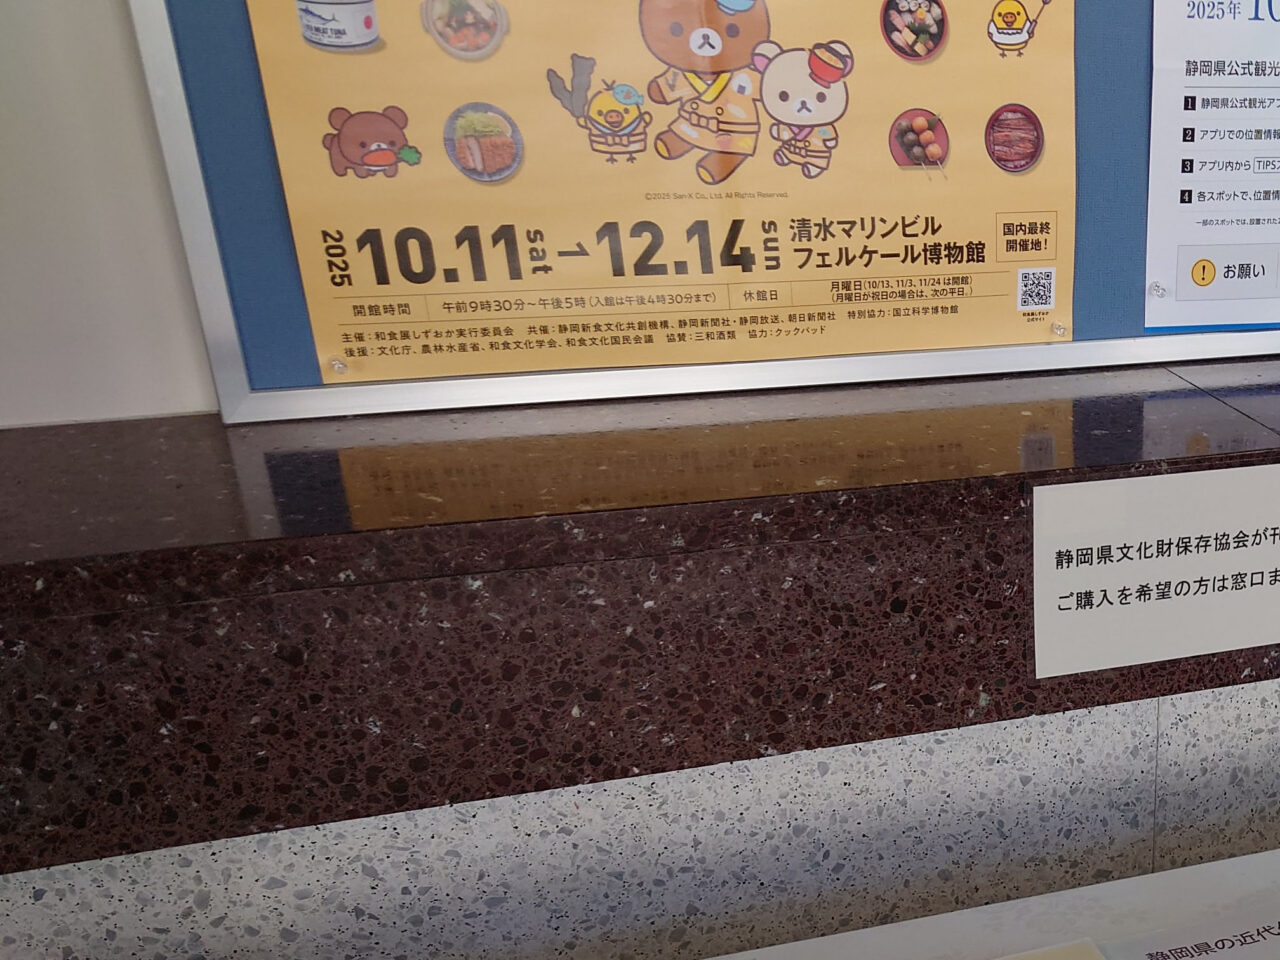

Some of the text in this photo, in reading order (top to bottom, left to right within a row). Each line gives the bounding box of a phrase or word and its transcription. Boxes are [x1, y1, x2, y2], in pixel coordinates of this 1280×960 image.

[1198, 160, 1252, 171] アプリ内から
[789, 215, 943, 243] 清水マリンビル
[1002, 221, 1051, 237] 国内最終
[321, 229, 353, 287] 2025
[356, 224, 523, 286] 10.11
[526, 228, 553, 275] sat
[595, 218, 757, 278] 12.14
[761, 219, 782, 271] sun
[793, 240, 987, 270] フェルケール博物館
[1223, 263, 1266, 279] お願い
[352, 302, 411, 317] 開館時間
[743, 289, 779, 302] 休館日
